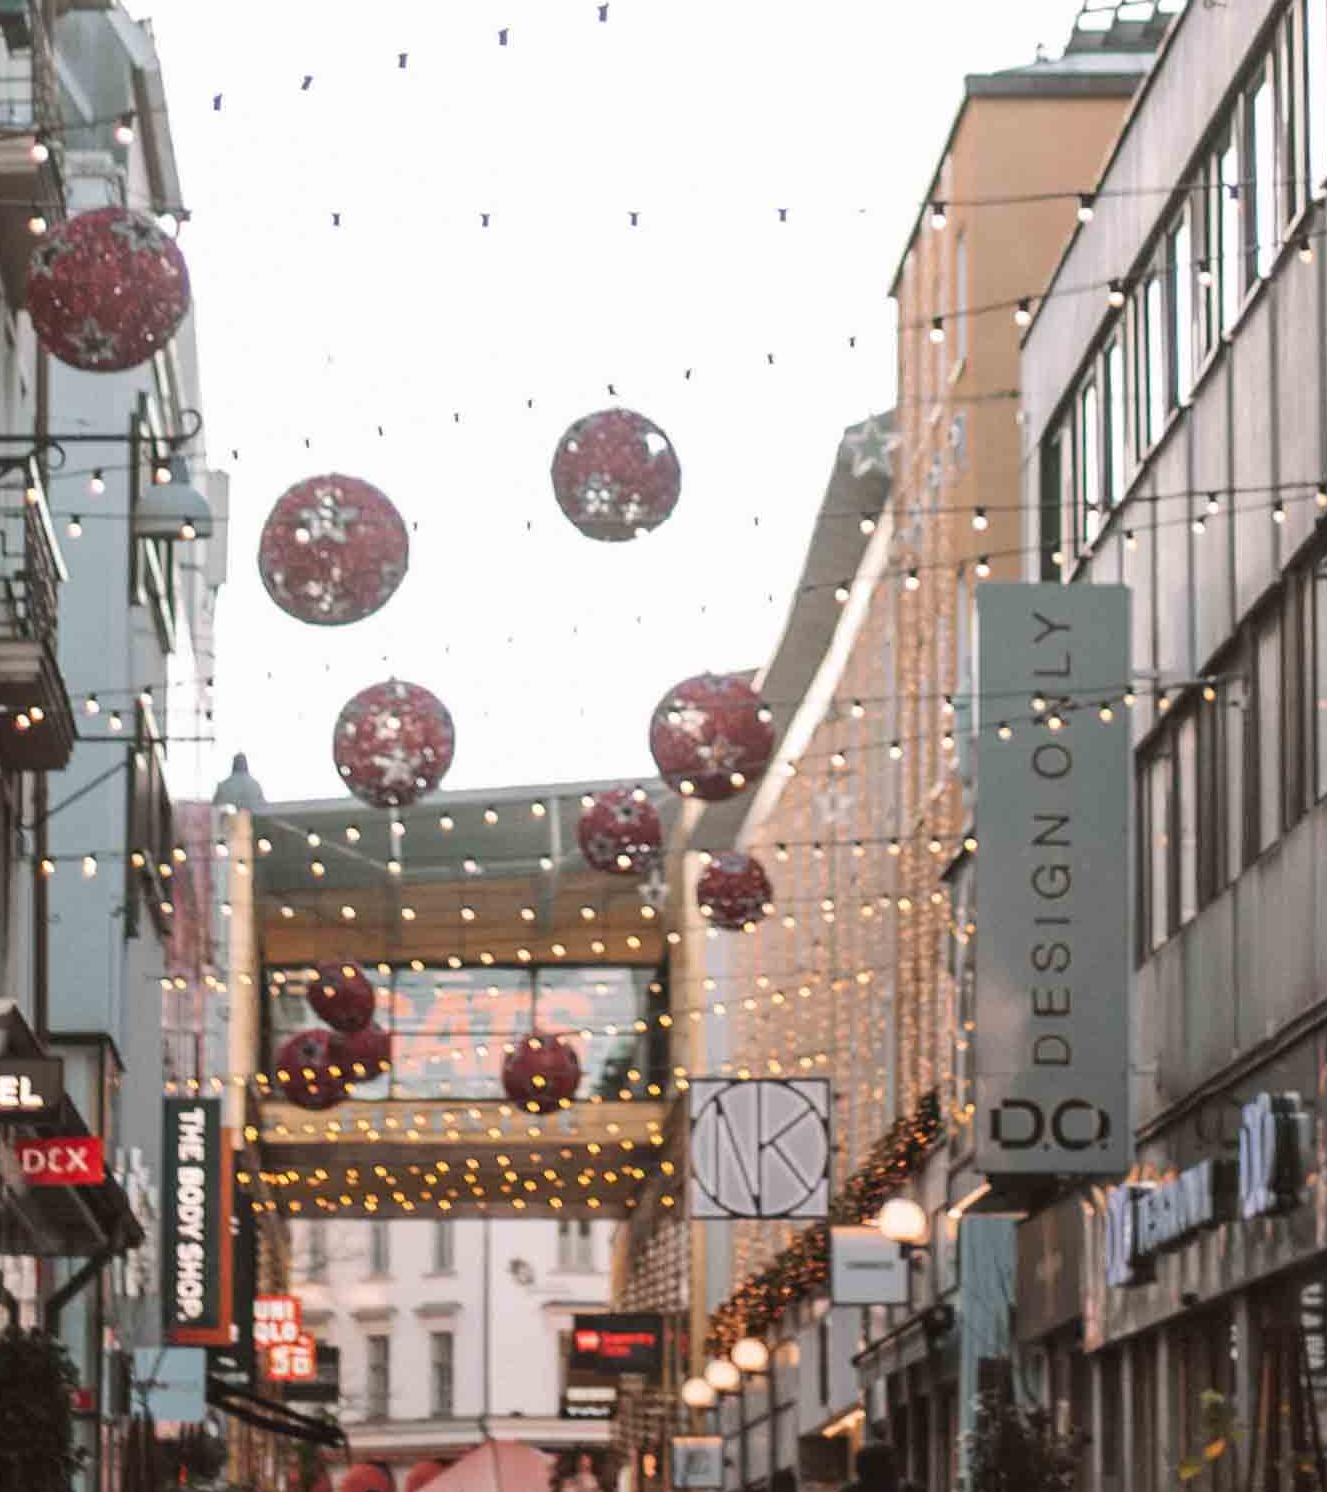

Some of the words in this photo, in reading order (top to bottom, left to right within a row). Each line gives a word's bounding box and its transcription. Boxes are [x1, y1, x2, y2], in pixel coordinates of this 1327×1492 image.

[1032, 609, 1074, 781] ONLY
[1032, 813, 1074, 1069] DESIGN
[177, 1107, 205, 1163] THE
[710, 1080, 818, 1216] NK
[177, 1166, 205, 1241] BODY
